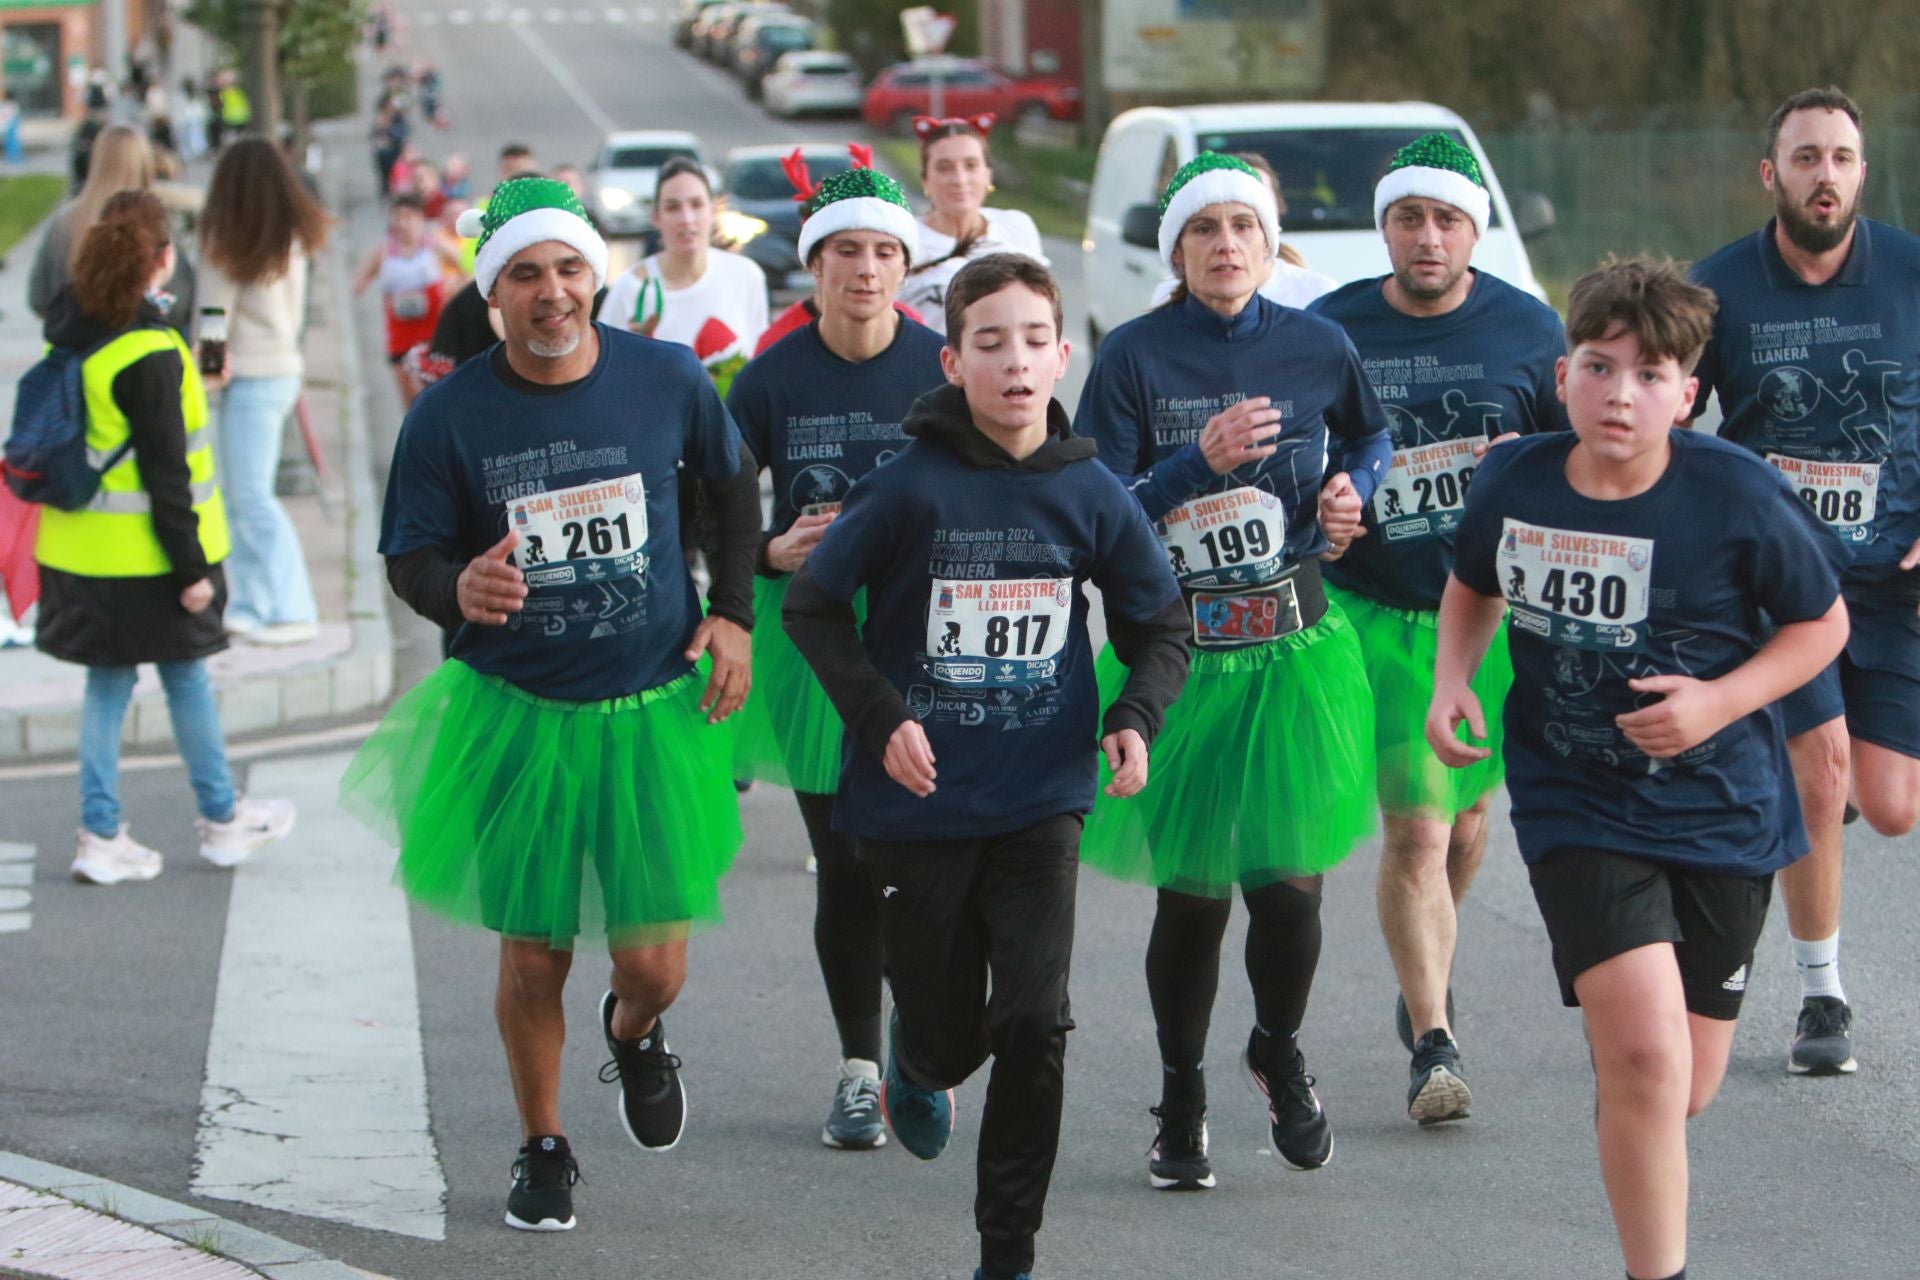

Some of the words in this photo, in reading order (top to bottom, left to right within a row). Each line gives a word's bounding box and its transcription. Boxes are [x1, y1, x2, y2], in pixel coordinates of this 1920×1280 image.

[1750, 323, 1761, 335] 31
[1762, 320, 1811, 333] diciembre
[1813, 316, 1838, 329] 2024
[1784, 330, 1813, 347] SAN
[1814, 322, 1882, 345] SILVESTRE
[1362, 357, 1411, 370] diciembre
[1414, 356, 1439, 367] 2024
[1751, 346, 1809, 365] LLANERA
[1383, 367, 1412, 385] SAN
[1415, 363, 1485, 384] SILVESTRE
[1155, 398, 1166, 411] 31
[1168, 396, 1219, 411] diciembre
[787, 416, 797, 428] 31
[799, 413, 845, 427] diciembre
[848, 411, 873, 424] 2024
[819, 425, 847, 442] SAN
[482, 458, 493, 471] 31
[495, 446, 546, 469] diciembre
[549, 440, 576, 455] 2024
[787, 443, 844, 460] LLANERA
[1391, 453, 1408, 469] AN
[1411, 441, 1470, 465] SILVESTRE
[518, 458, 549, 480] SAN
[552, 446, 628, 474] SILVESTRE
[1407, 459, 1453, 477] LLANERA
[1780, 458, 1802, 473] SAN
[1806, 463, 1863, 478] SILVESTRE
[1798, 476, 1842, 487] LLANERA
[485, 479, 547, 505] LLANERA
[527, 498, 553, 515] SAN
[558, 481, 624, 508] SILVESTRE
[552, 503, 604, 522] LLANERA
[1166, 507, 1190, 526] SAN
[1194, 491, 1260, 517] SILVESTRE
[1190, 509, 1240, 531] LLANERA
[562, 512, 632, 560] 261
[933, 529, 947, 543] 31
[949, 528, 1004, 543] diciembre
[1007, 528, 1035, 542] 2024
[1199, 518, 1270, 569] 199
[1518, 528, 1545, 547] SAN
[1551, 533, 1628, 558] SILVESTRE
[614, 554, 635, 565] DICAR
[930, 543, 969, 563] XXXI
[970, 542, 1003, 562] SAN
[1540, 551, 1599, 568] LLANERA
[529, 570, 572, 582] OQUENDO
[928, 562, 996, 578] LLANERA
[955, 584, 983, 600] SAN
[988, 582, 1056, 600] SILVESTRE
[1540, 568, 1627, 620] 430
[978, 600, 1032, 612] LLANERA
[984, 614, 1053, 658] 817
[937, 666, 982, 677] OQUENDO
[1026, 661, 1048, 670] DICAR
[936, 701, 967, 712] DICAR
